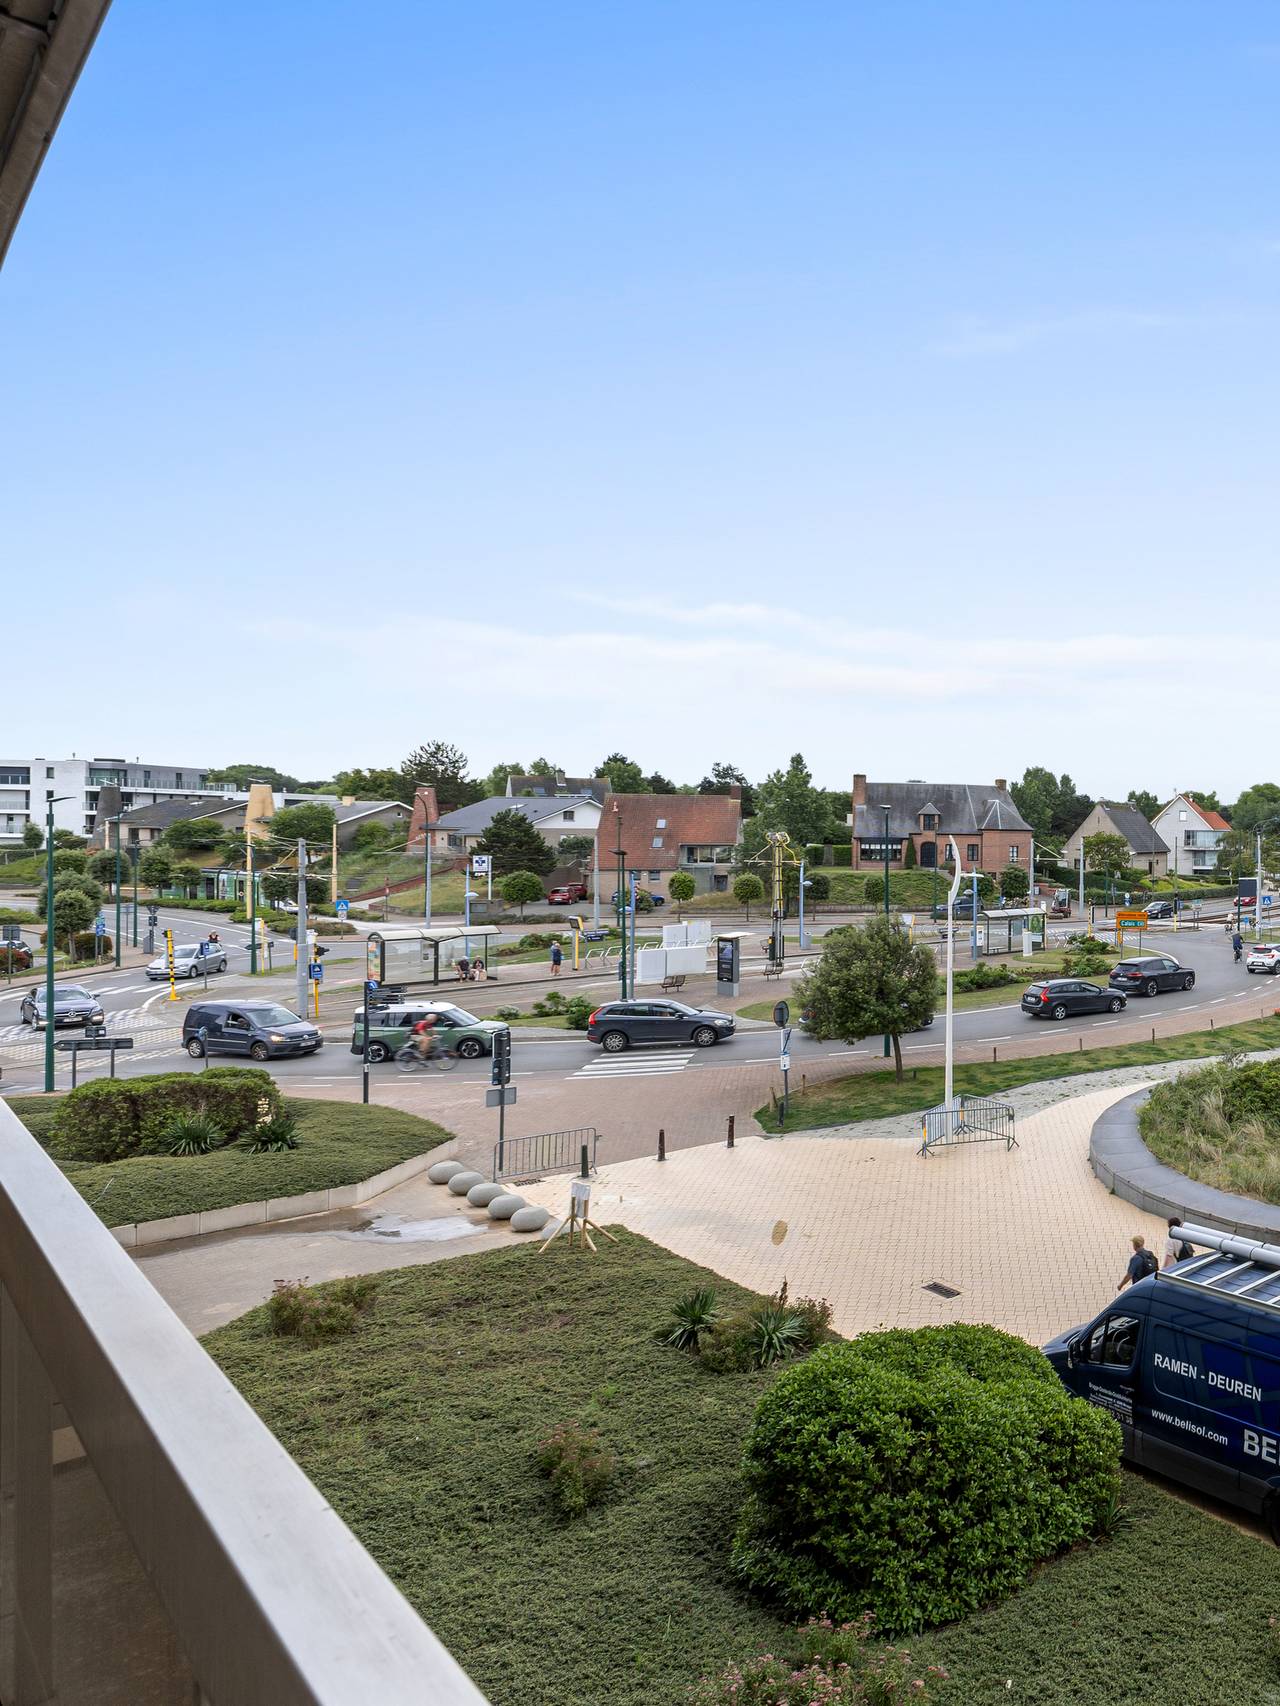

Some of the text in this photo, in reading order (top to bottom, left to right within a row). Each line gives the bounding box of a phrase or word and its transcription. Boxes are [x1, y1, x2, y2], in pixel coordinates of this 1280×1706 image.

[1154, 1353, 1197, 1380] RAMEN
[1208, 1372, 1262, 1402] DEUREN
[1151, 1408, 1228, 1446] www.belisol.com
